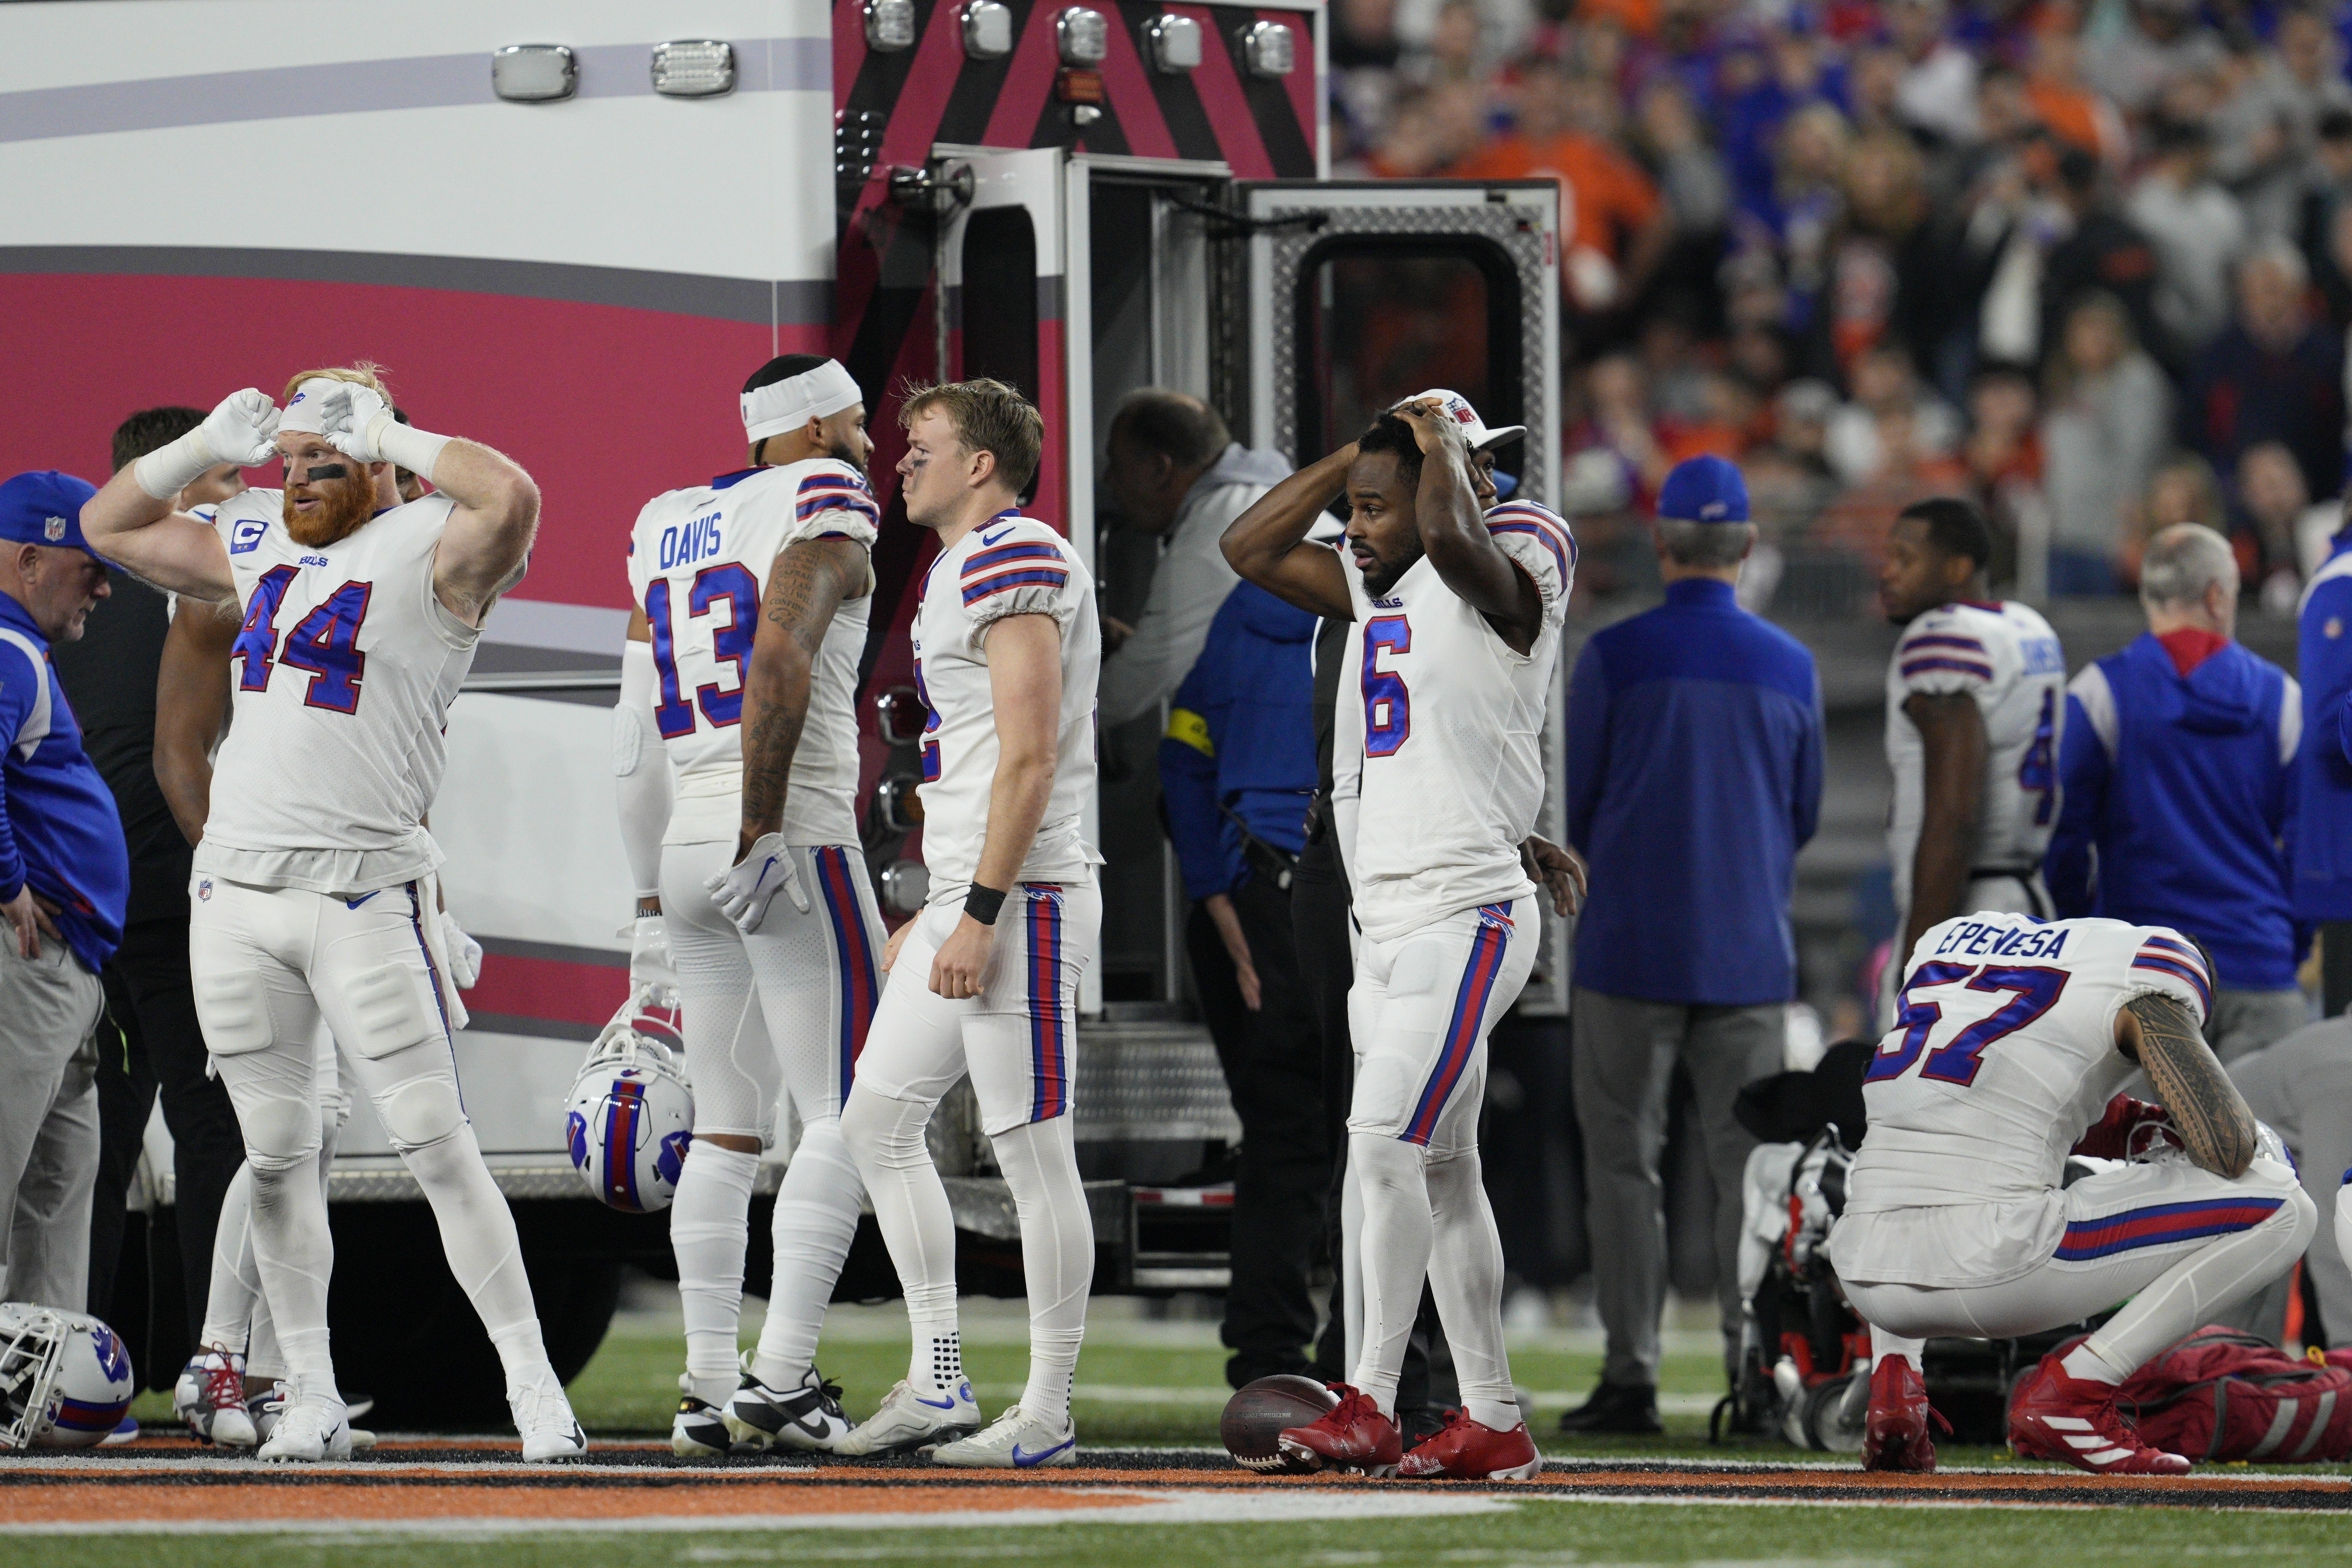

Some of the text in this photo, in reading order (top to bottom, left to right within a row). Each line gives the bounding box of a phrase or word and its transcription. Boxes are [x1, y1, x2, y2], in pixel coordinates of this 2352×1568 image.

[233, 521, 264, 544] C
[660, 512, 722, 569] DAVIS
[230, 564, 373, 716] 44
[645, 561, 761, 740] 13
[1361, 613, 1412, 758] 6
[199, 888, 209, 897] NFL
[1935, 922, 2071, 959] EPENESA
[1862, 960, 2072, 1087] 57
